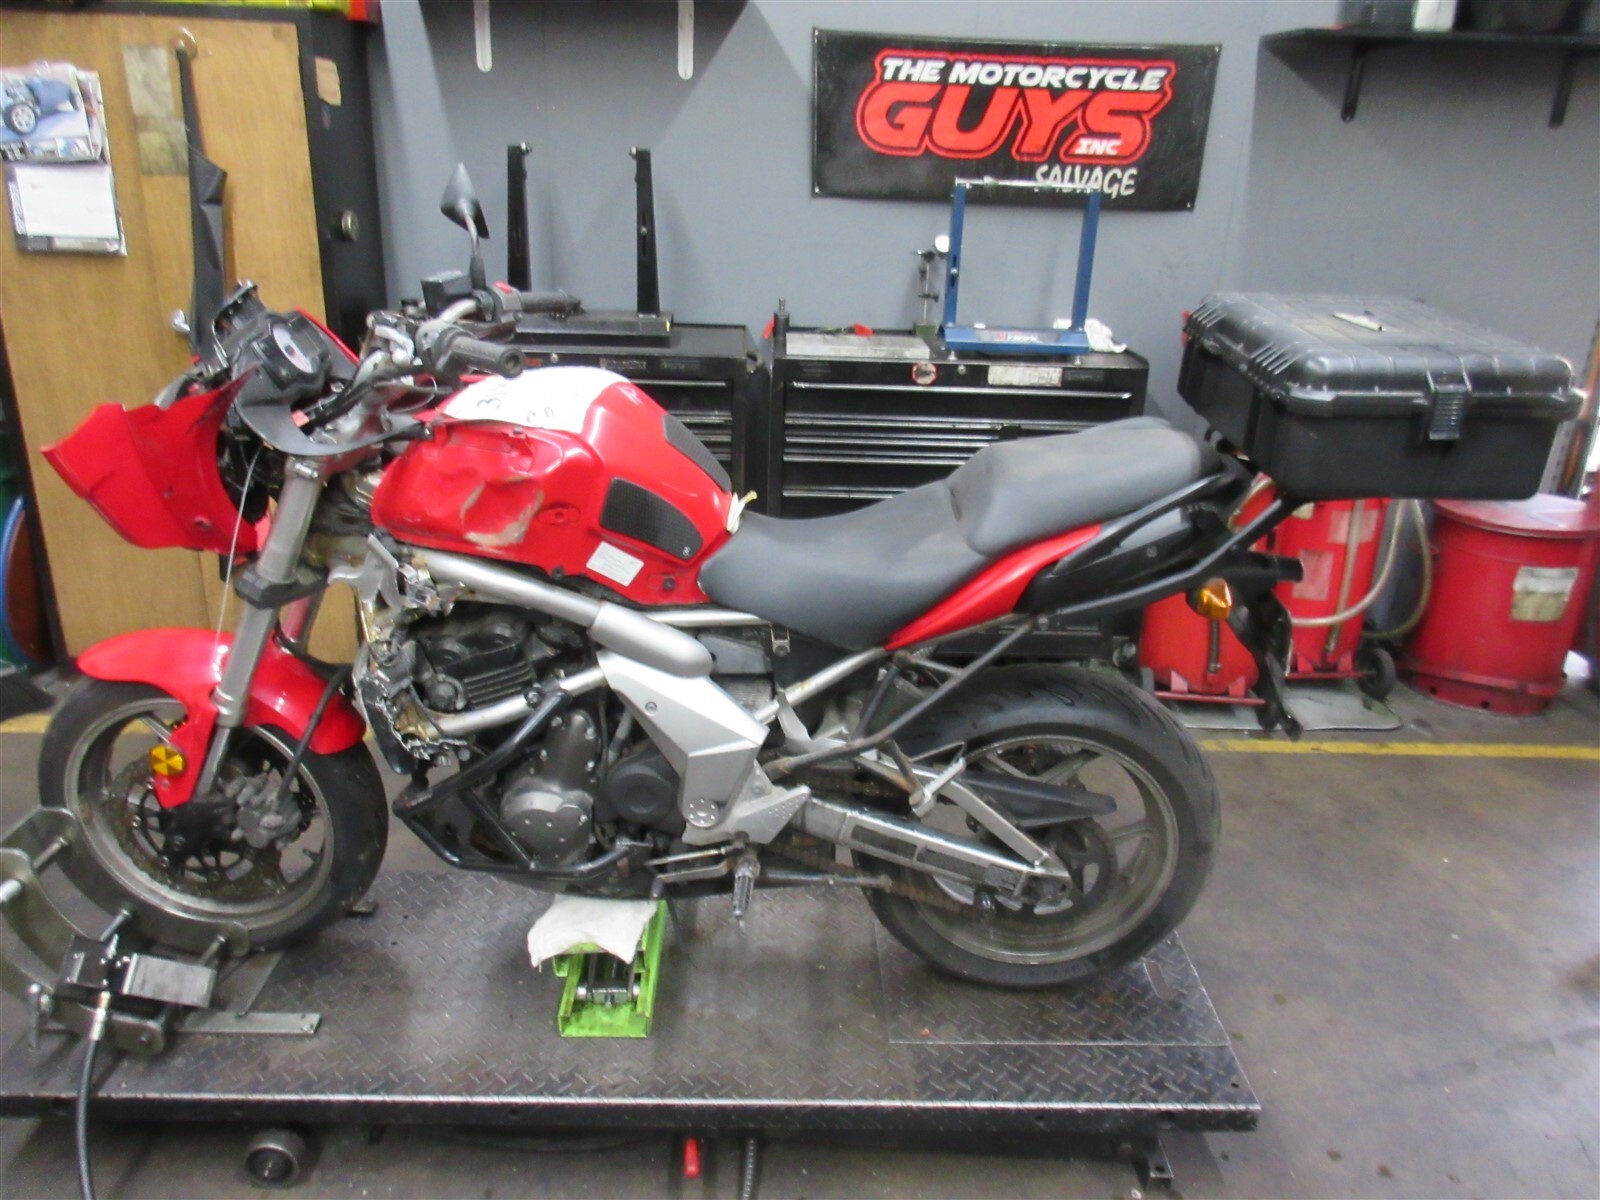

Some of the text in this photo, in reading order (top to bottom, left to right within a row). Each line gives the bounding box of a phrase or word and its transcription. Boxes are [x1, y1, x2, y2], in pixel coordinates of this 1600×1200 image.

[882, 58, 1168, 91] THE MOTORCYCLE
[863, 82, 1164, 155] GUYS
[1074, 137, 1123, 155] INC
[1034, 164, 1138, 199] SALVAGE
